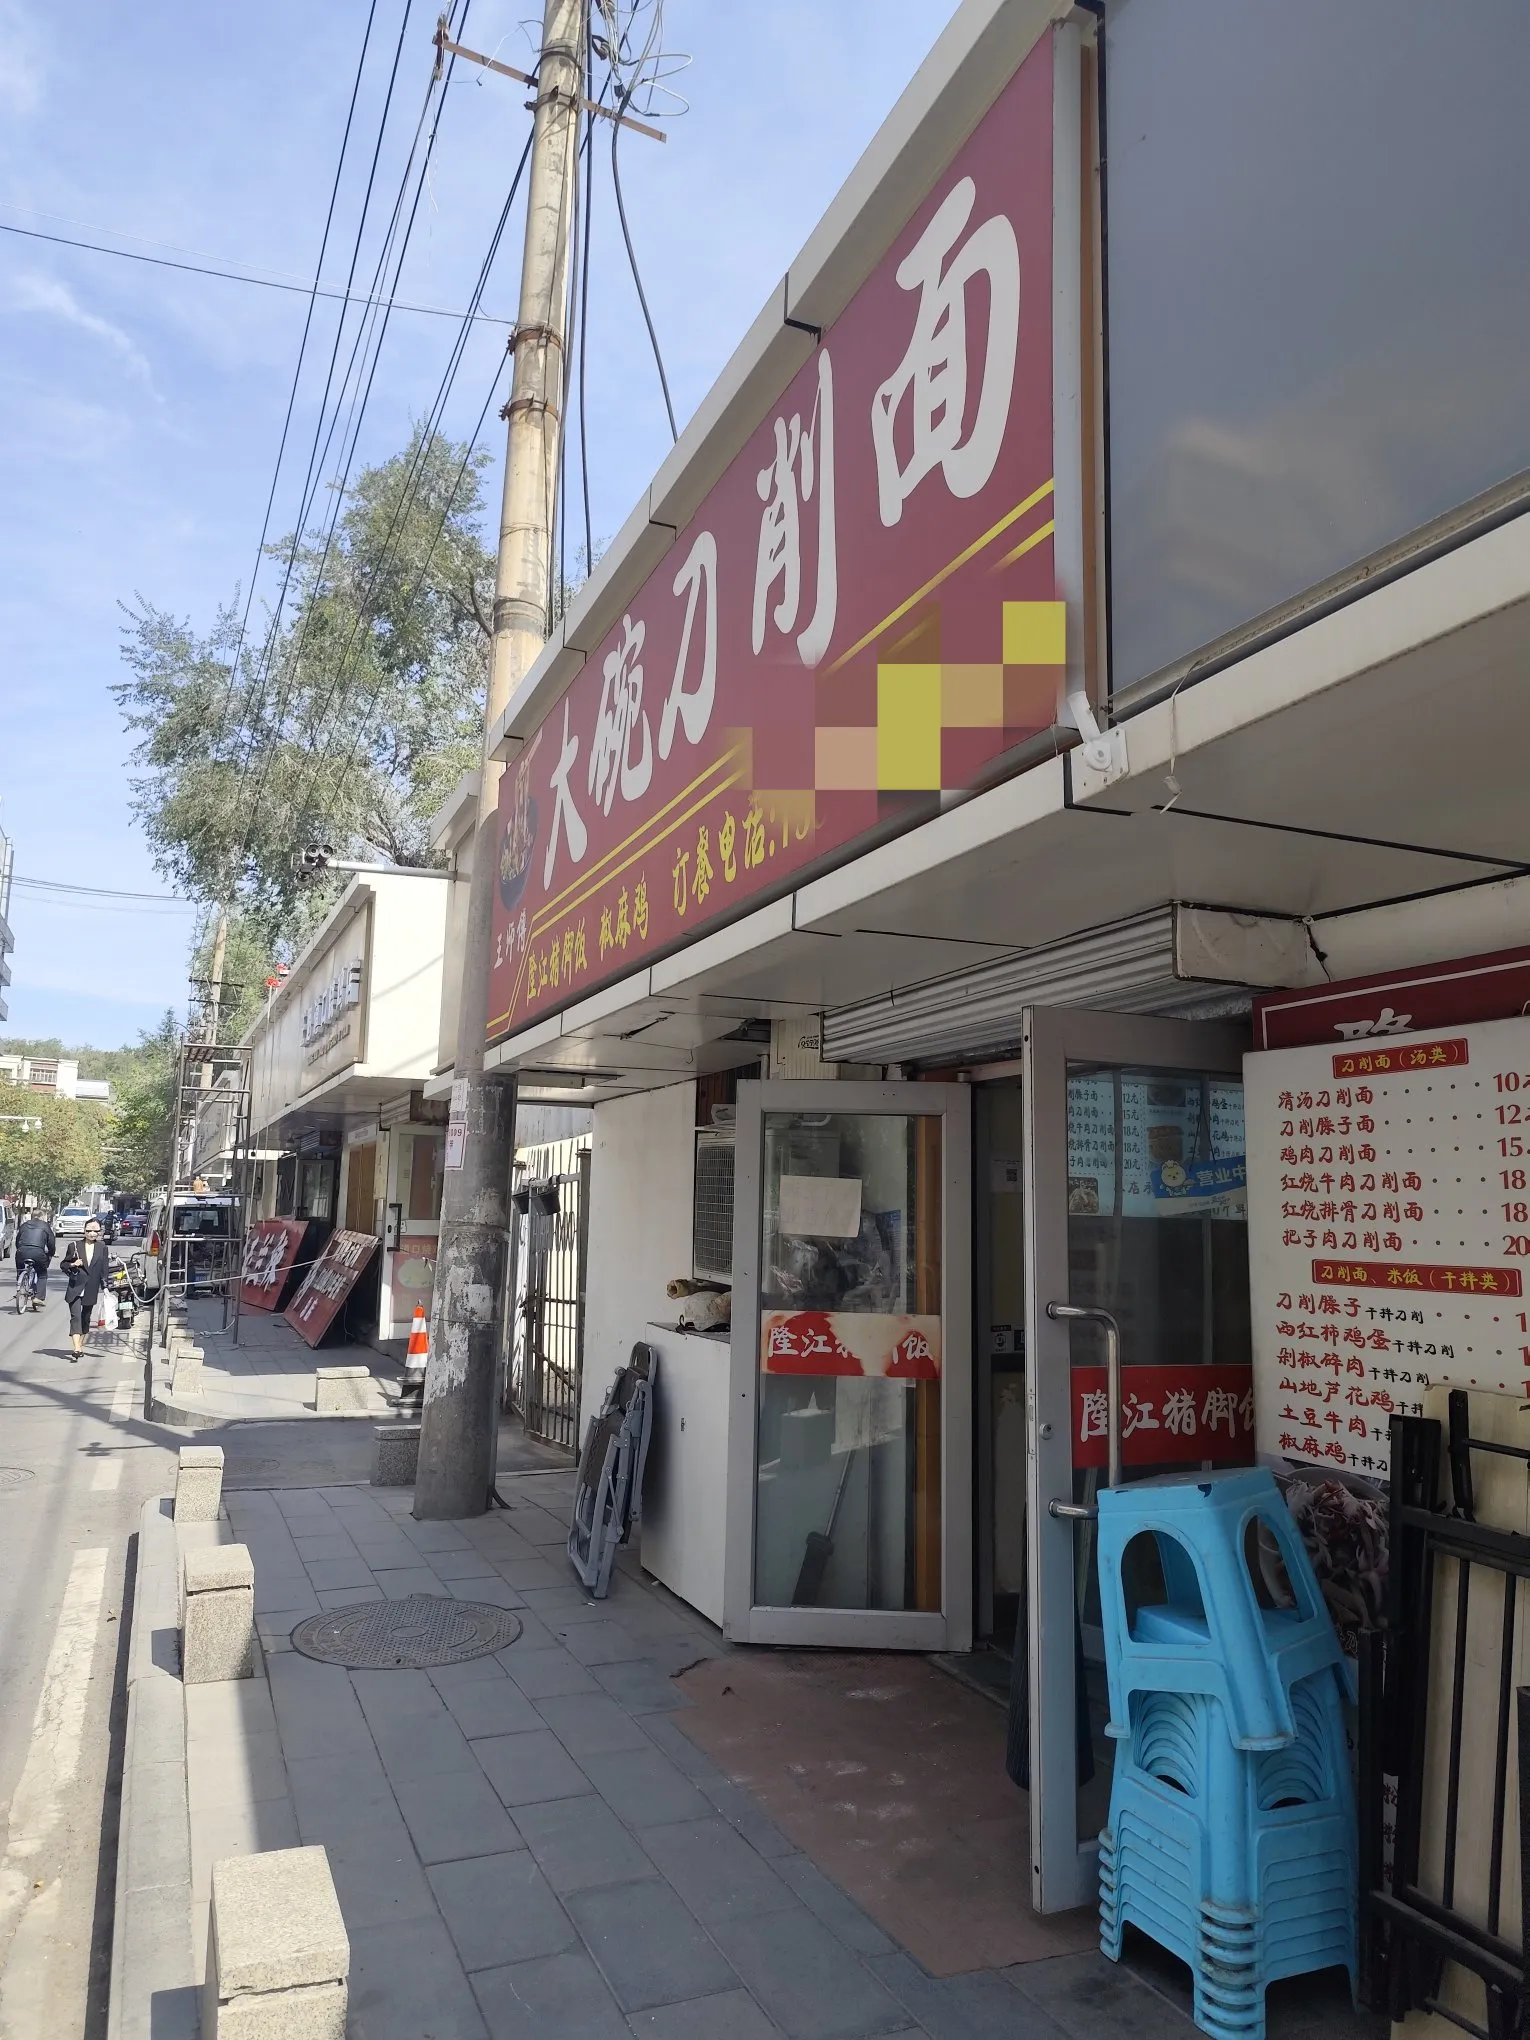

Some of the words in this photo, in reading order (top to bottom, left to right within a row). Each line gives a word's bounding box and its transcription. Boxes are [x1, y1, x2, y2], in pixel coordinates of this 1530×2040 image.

[543, 176, 1020, 891] 大碗刀削面
[494, 907, 527, 969] 王师傅
[526, 917, 588, 1007] 隆江猪脚饭
[599, 871, 649, 961] 椒麻鸡
[1277, 1086, 1374, 1111] 清汤刀削面
[1280, 1114, 1375, 1138] 刀削臊子面
[1280, 1143, 1376, 1166] 鸡肉刀削面
[1280, 1171, 1422, 1194] 红烧牛肉刀削面
[1281, 1200, 1424, 1223] 红烧排骨刀削面
[1282, 1228, 1402, 1252] 把子肉刀削面
[1276, 1292, 1361, 1317] 刀削臊子
[1365, 1306, 1424, 1324] 干拌刀削
[768, 1326, 935, 1365] 隆江饭
[1276, 1320, 1391, 1351] 西红柿鸡蛋
[1391, 1340, 1455, 1359] 干拌刀削
[1276, 1347, 1365, 1378] 剁椒碎肉
[1368, 1367, 1430, 1386] 干拌刀削
[1279, 1377, 1395, 1413] 山地芦花鸡
[1278, 1404, 1367, 1438] 土豆牛肉
[1279, 1432, 1347, 1464] 椒麻鸡
